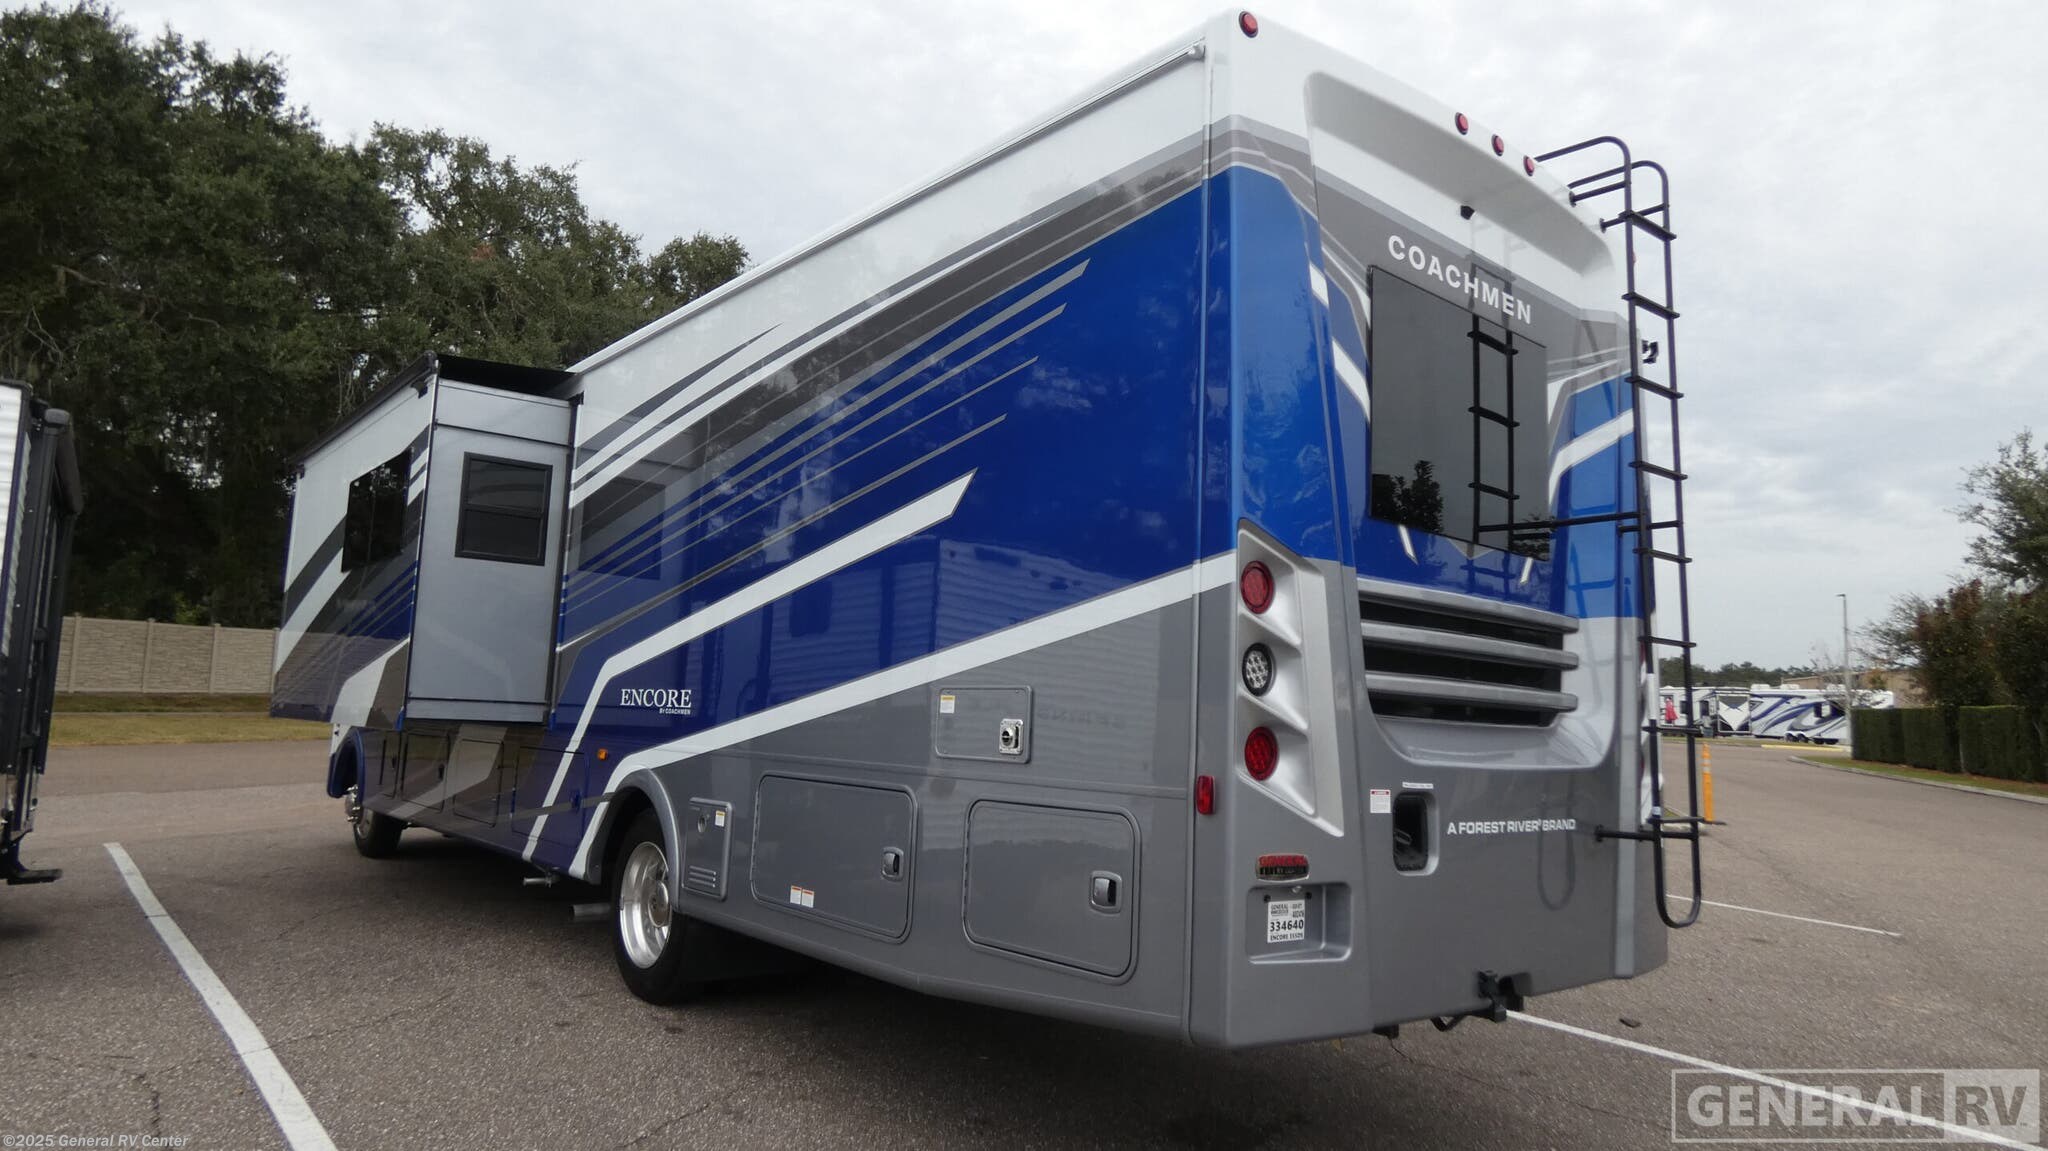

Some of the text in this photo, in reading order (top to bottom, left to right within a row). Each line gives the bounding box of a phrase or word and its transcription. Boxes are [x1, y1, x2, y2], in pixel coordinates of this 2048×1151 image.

[1387, 234, 1532, 325] COACHMEN
[620, 688, 692, 708] ENCORE
[1447, 822, 1457, 835] A
[1458, 820, 1506, 835] FOREST
[1542, 818, 1577, 832] BRAND
[1269, 919, 1304, 932] 334640
